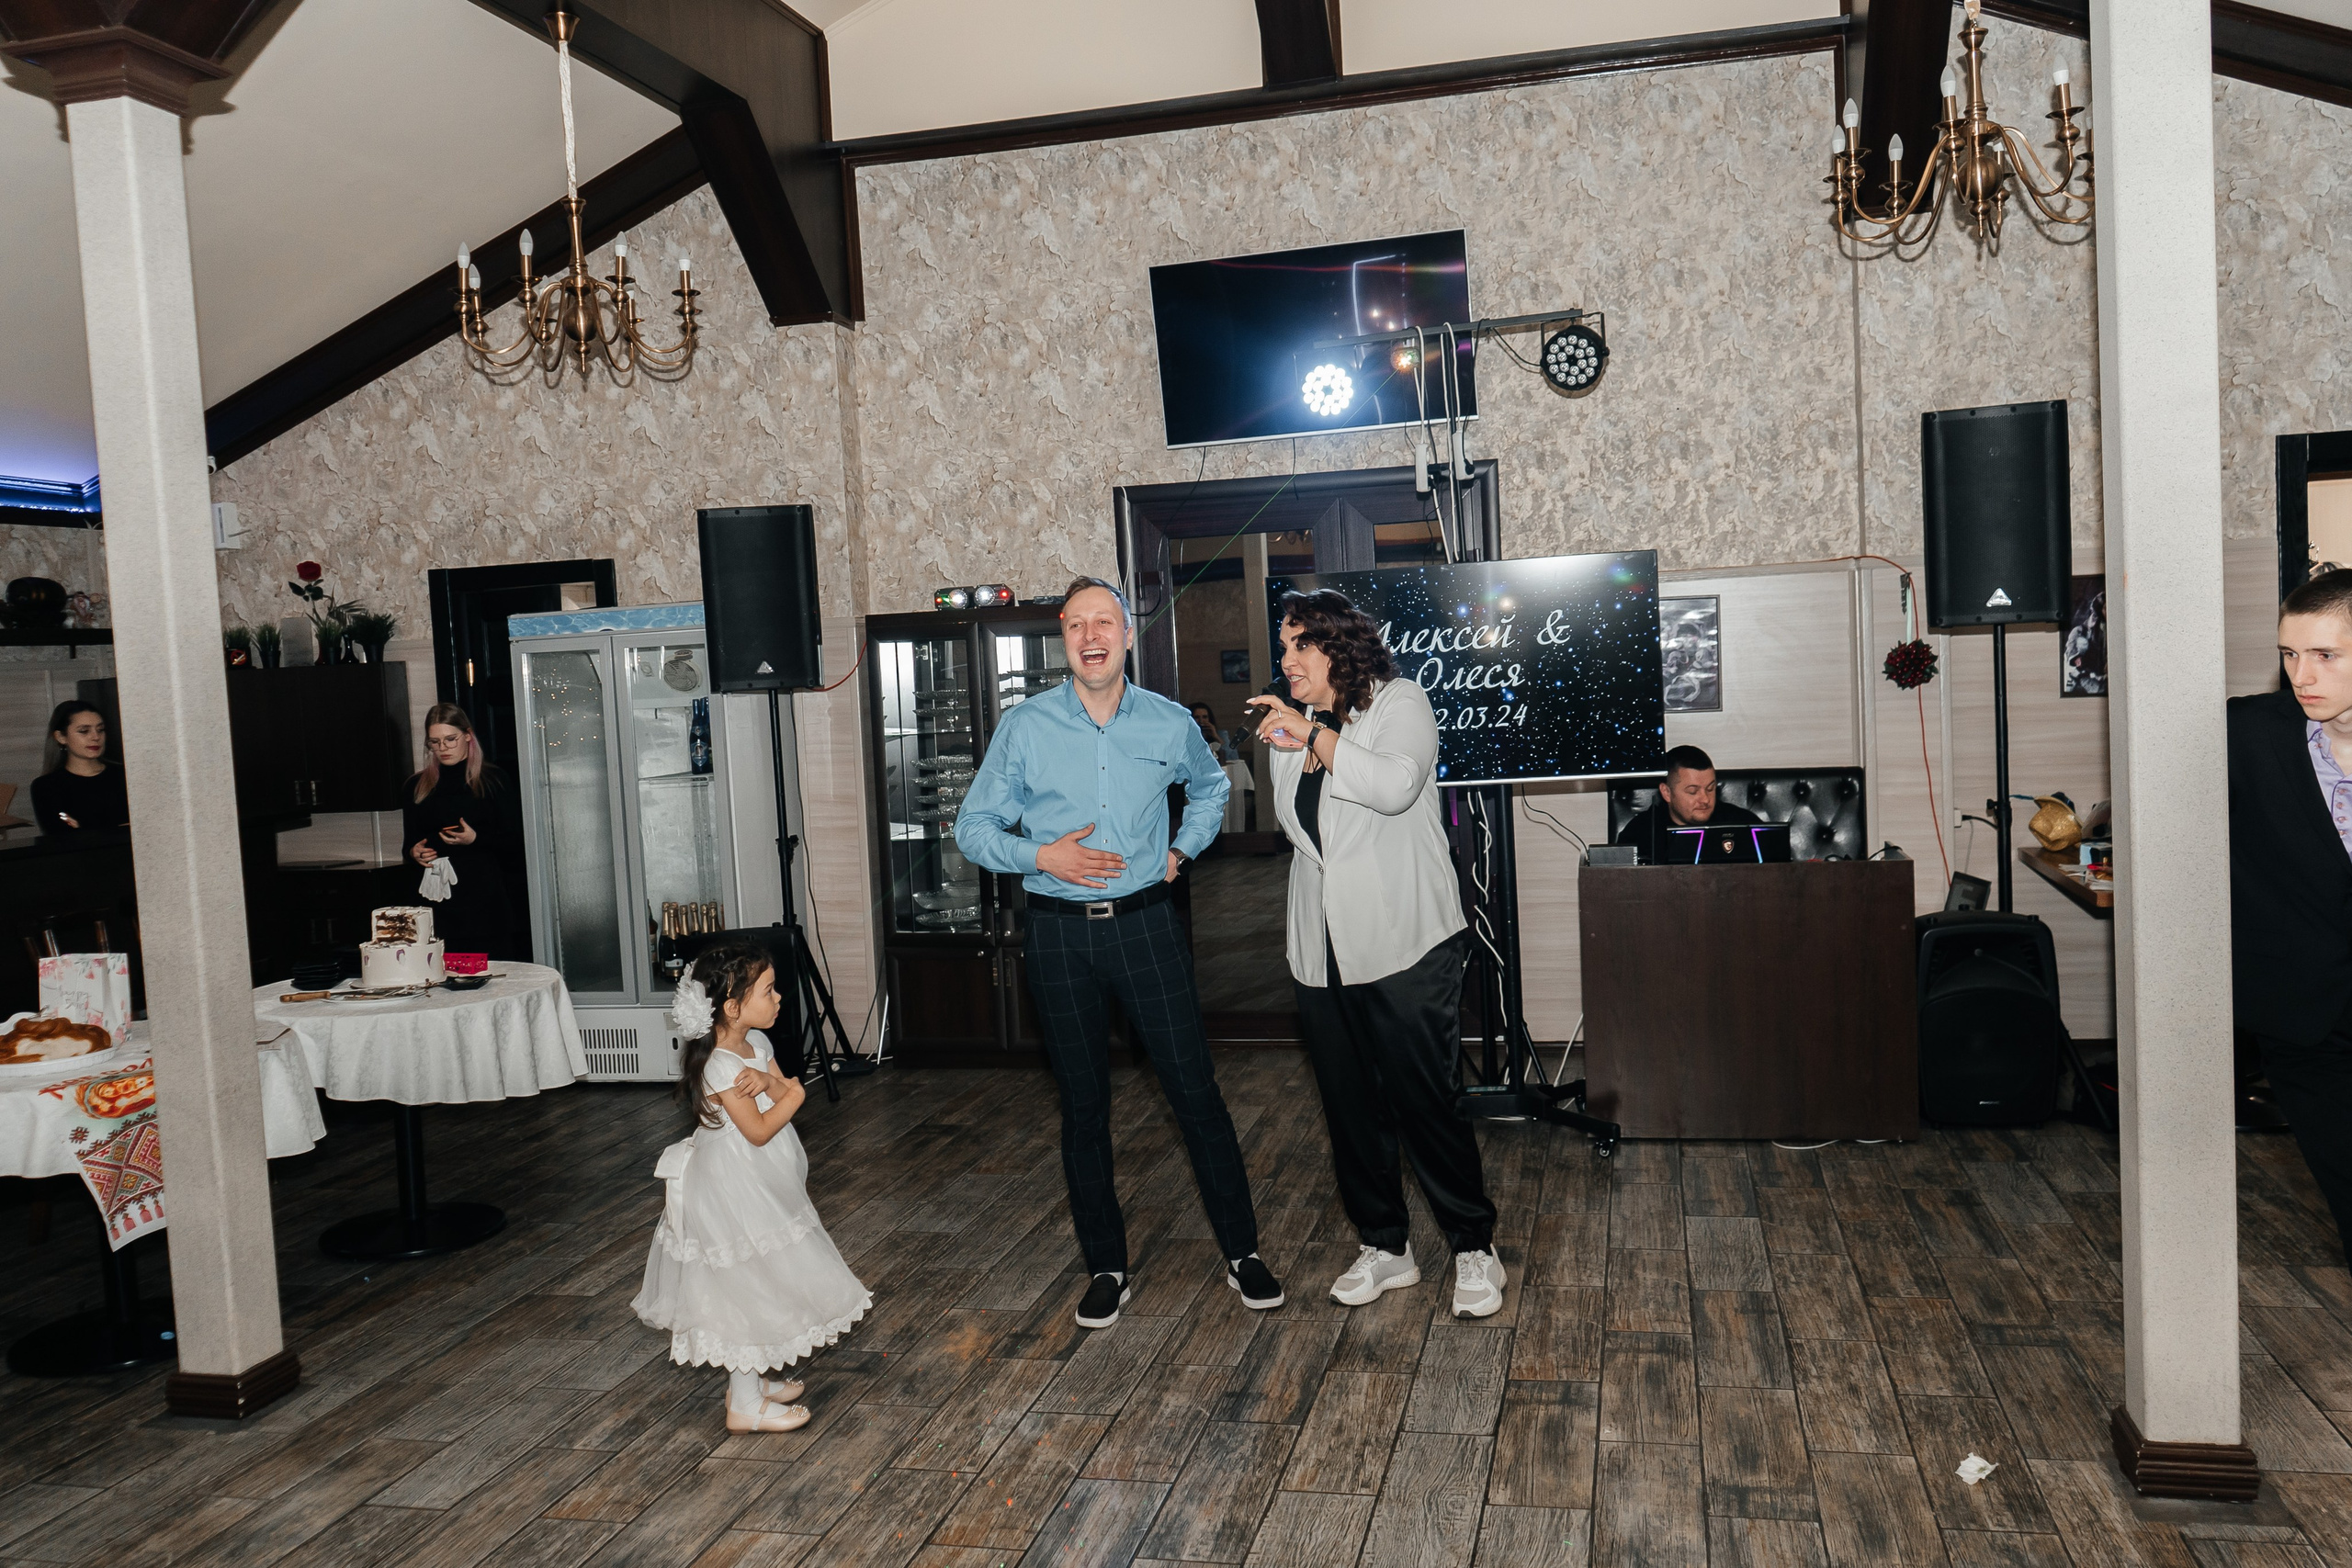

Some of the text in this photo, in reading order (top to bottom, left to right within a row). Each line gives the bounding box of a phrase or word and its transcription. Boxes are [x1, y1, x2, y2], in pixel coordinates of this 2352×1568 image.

[1377, 609, 1570, 654] Алексей &
[1416, 657, 1525, 692] Олеся
[1435, 703, 1528, 730] 2.03.24
